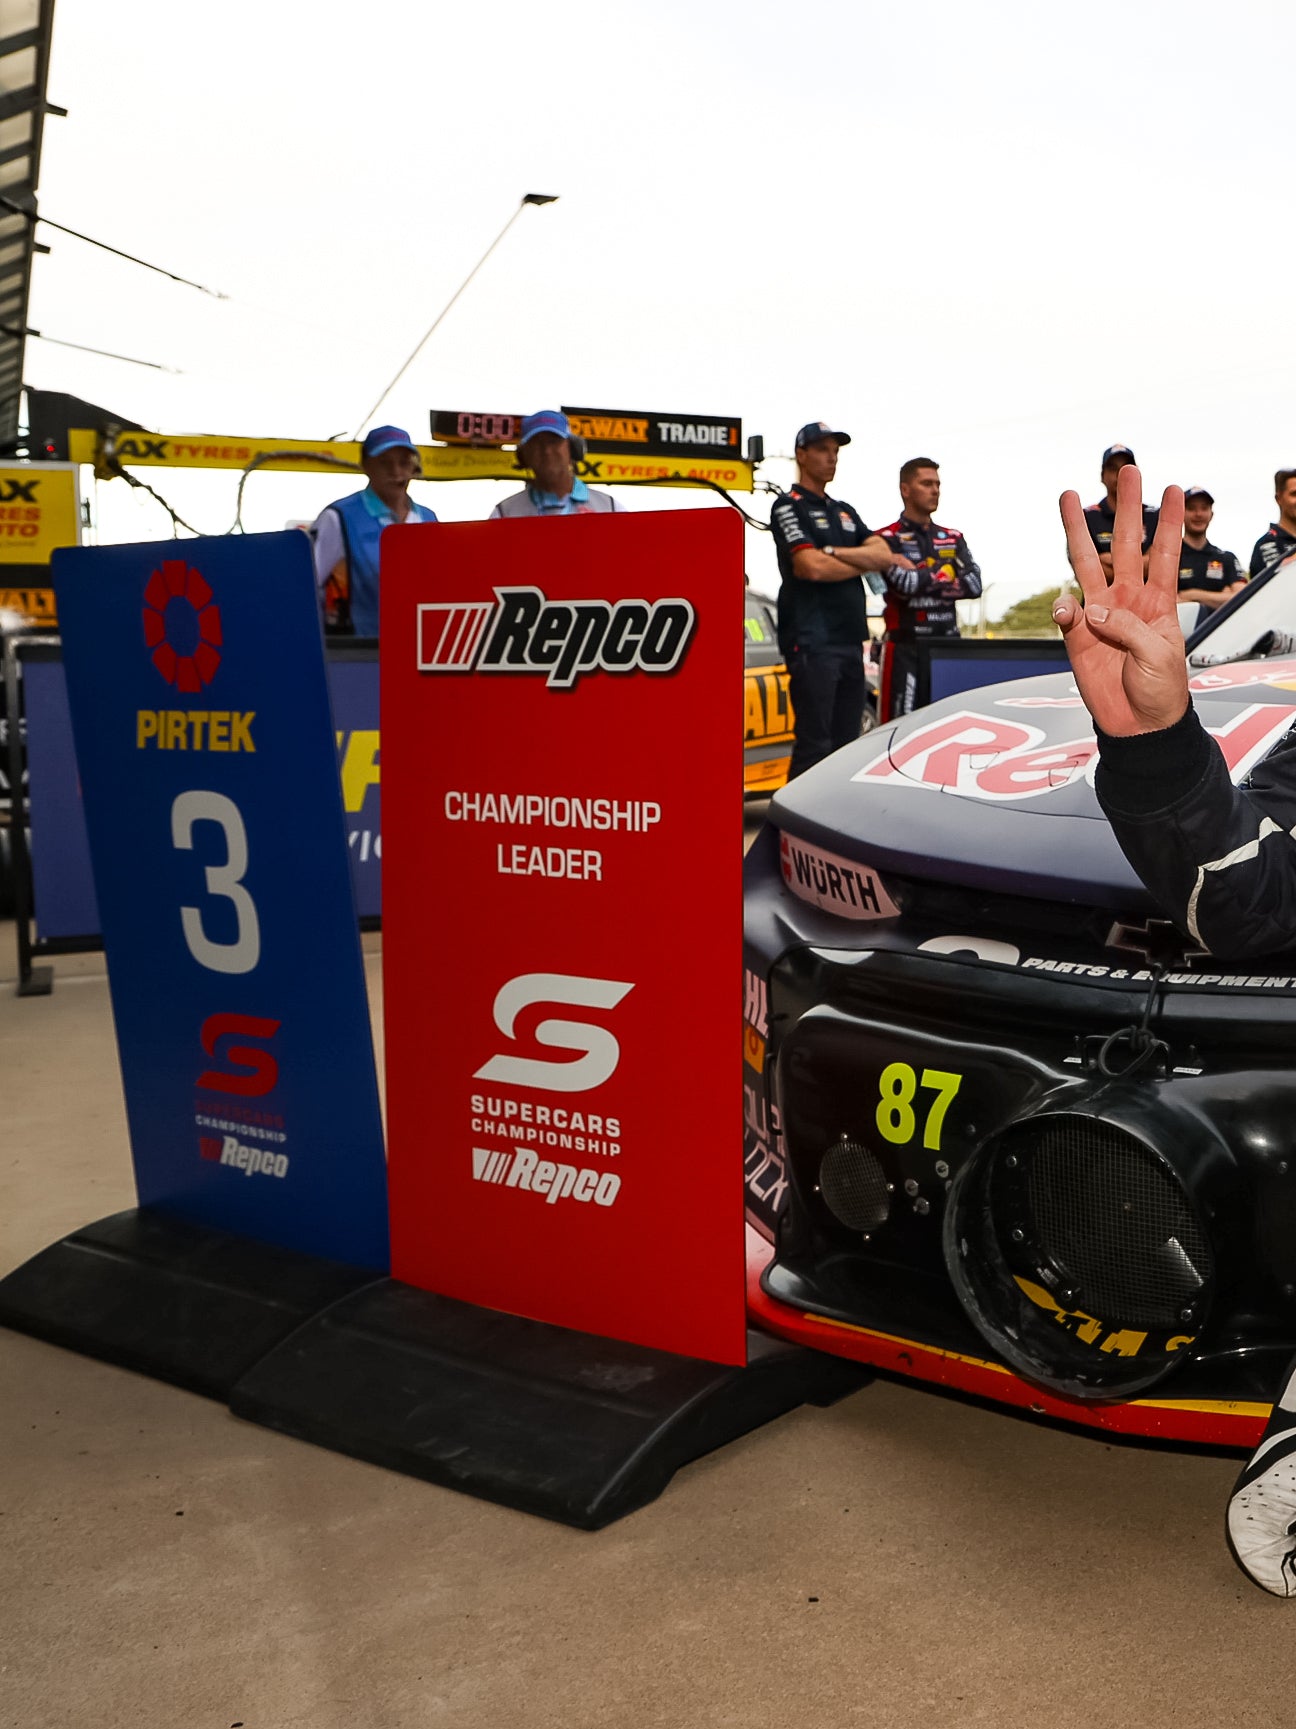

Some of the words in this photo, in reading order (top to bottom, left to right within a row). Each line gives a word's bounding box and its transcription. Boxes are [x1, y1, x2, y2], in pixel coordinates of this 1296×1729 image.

[657, 421, 728, 446] TRADIE
[687, 468, 738, 481] AUTO
[475, 586, 695, 687] Repco
[137, 710, 256, 752] PIRTEK
[444, 791, 662, 832] CHAMPIONSHIP
[171, 790, 260, 974] 3
[497, 843, 602, 881] LEADER
[791, 846, 882, 914] WÜRTH
[1021, 958, 1109, 978] PARTS
[1110, 969, 1129, 980] &
[471, 1094, 620, 1137] SUPERCARS
[876, 1062, 963, 1151] 87
[195, 1115, 287, 1143] CHAMPIONSHIP
[471, 1118, 620, 1156] CHAMPIONSHIP
[219, 1135, 289, 1178] Repco
[505, 1146, 621, 1207] Repco
